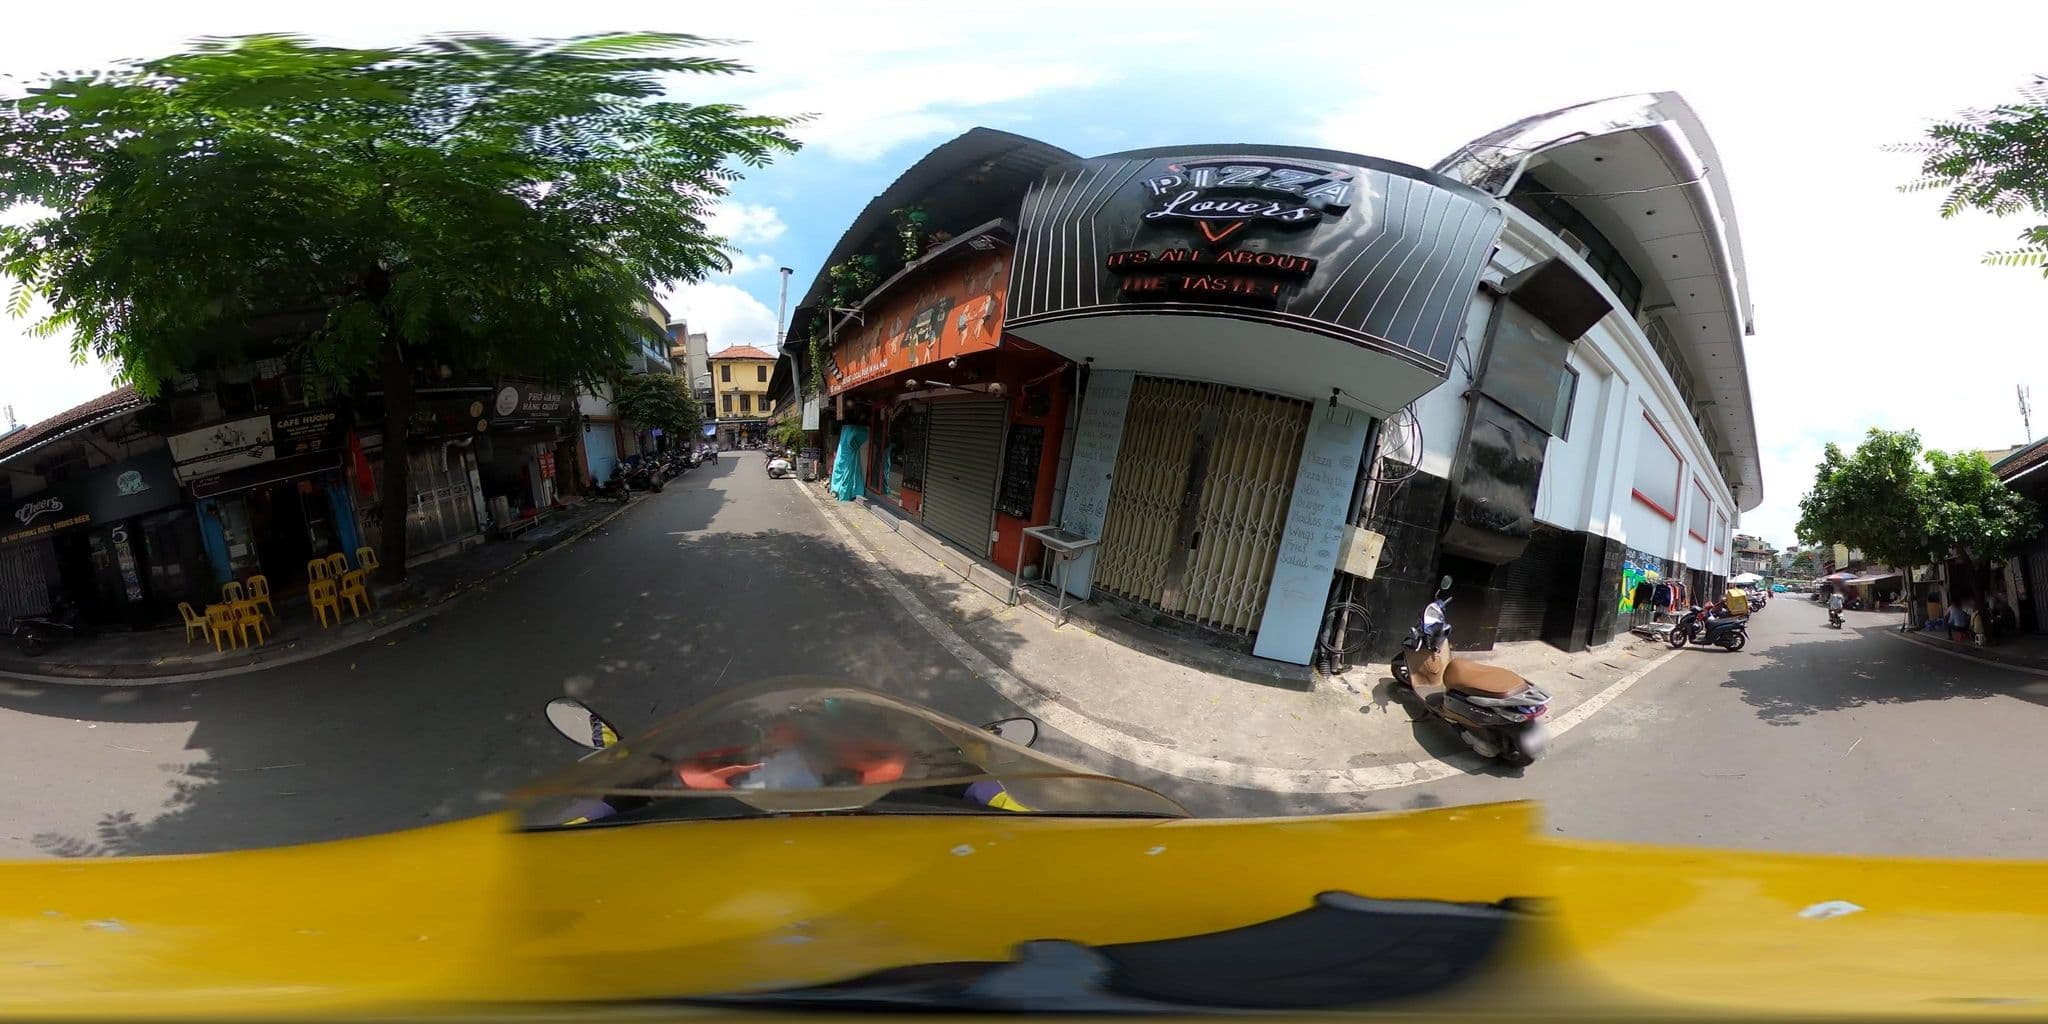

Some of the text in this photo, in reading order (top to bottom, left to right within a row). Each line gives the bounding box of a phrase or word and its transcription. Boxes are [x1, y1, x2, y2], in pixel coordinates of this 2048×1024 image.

[1148, 165, 1352, 205] PIZZA
[1145, 190, 1314, 220] Lovers
[1107, 249, 1311, 272] IT'S ALL ABOUT
[15, 496, 64, 526] Cheers
